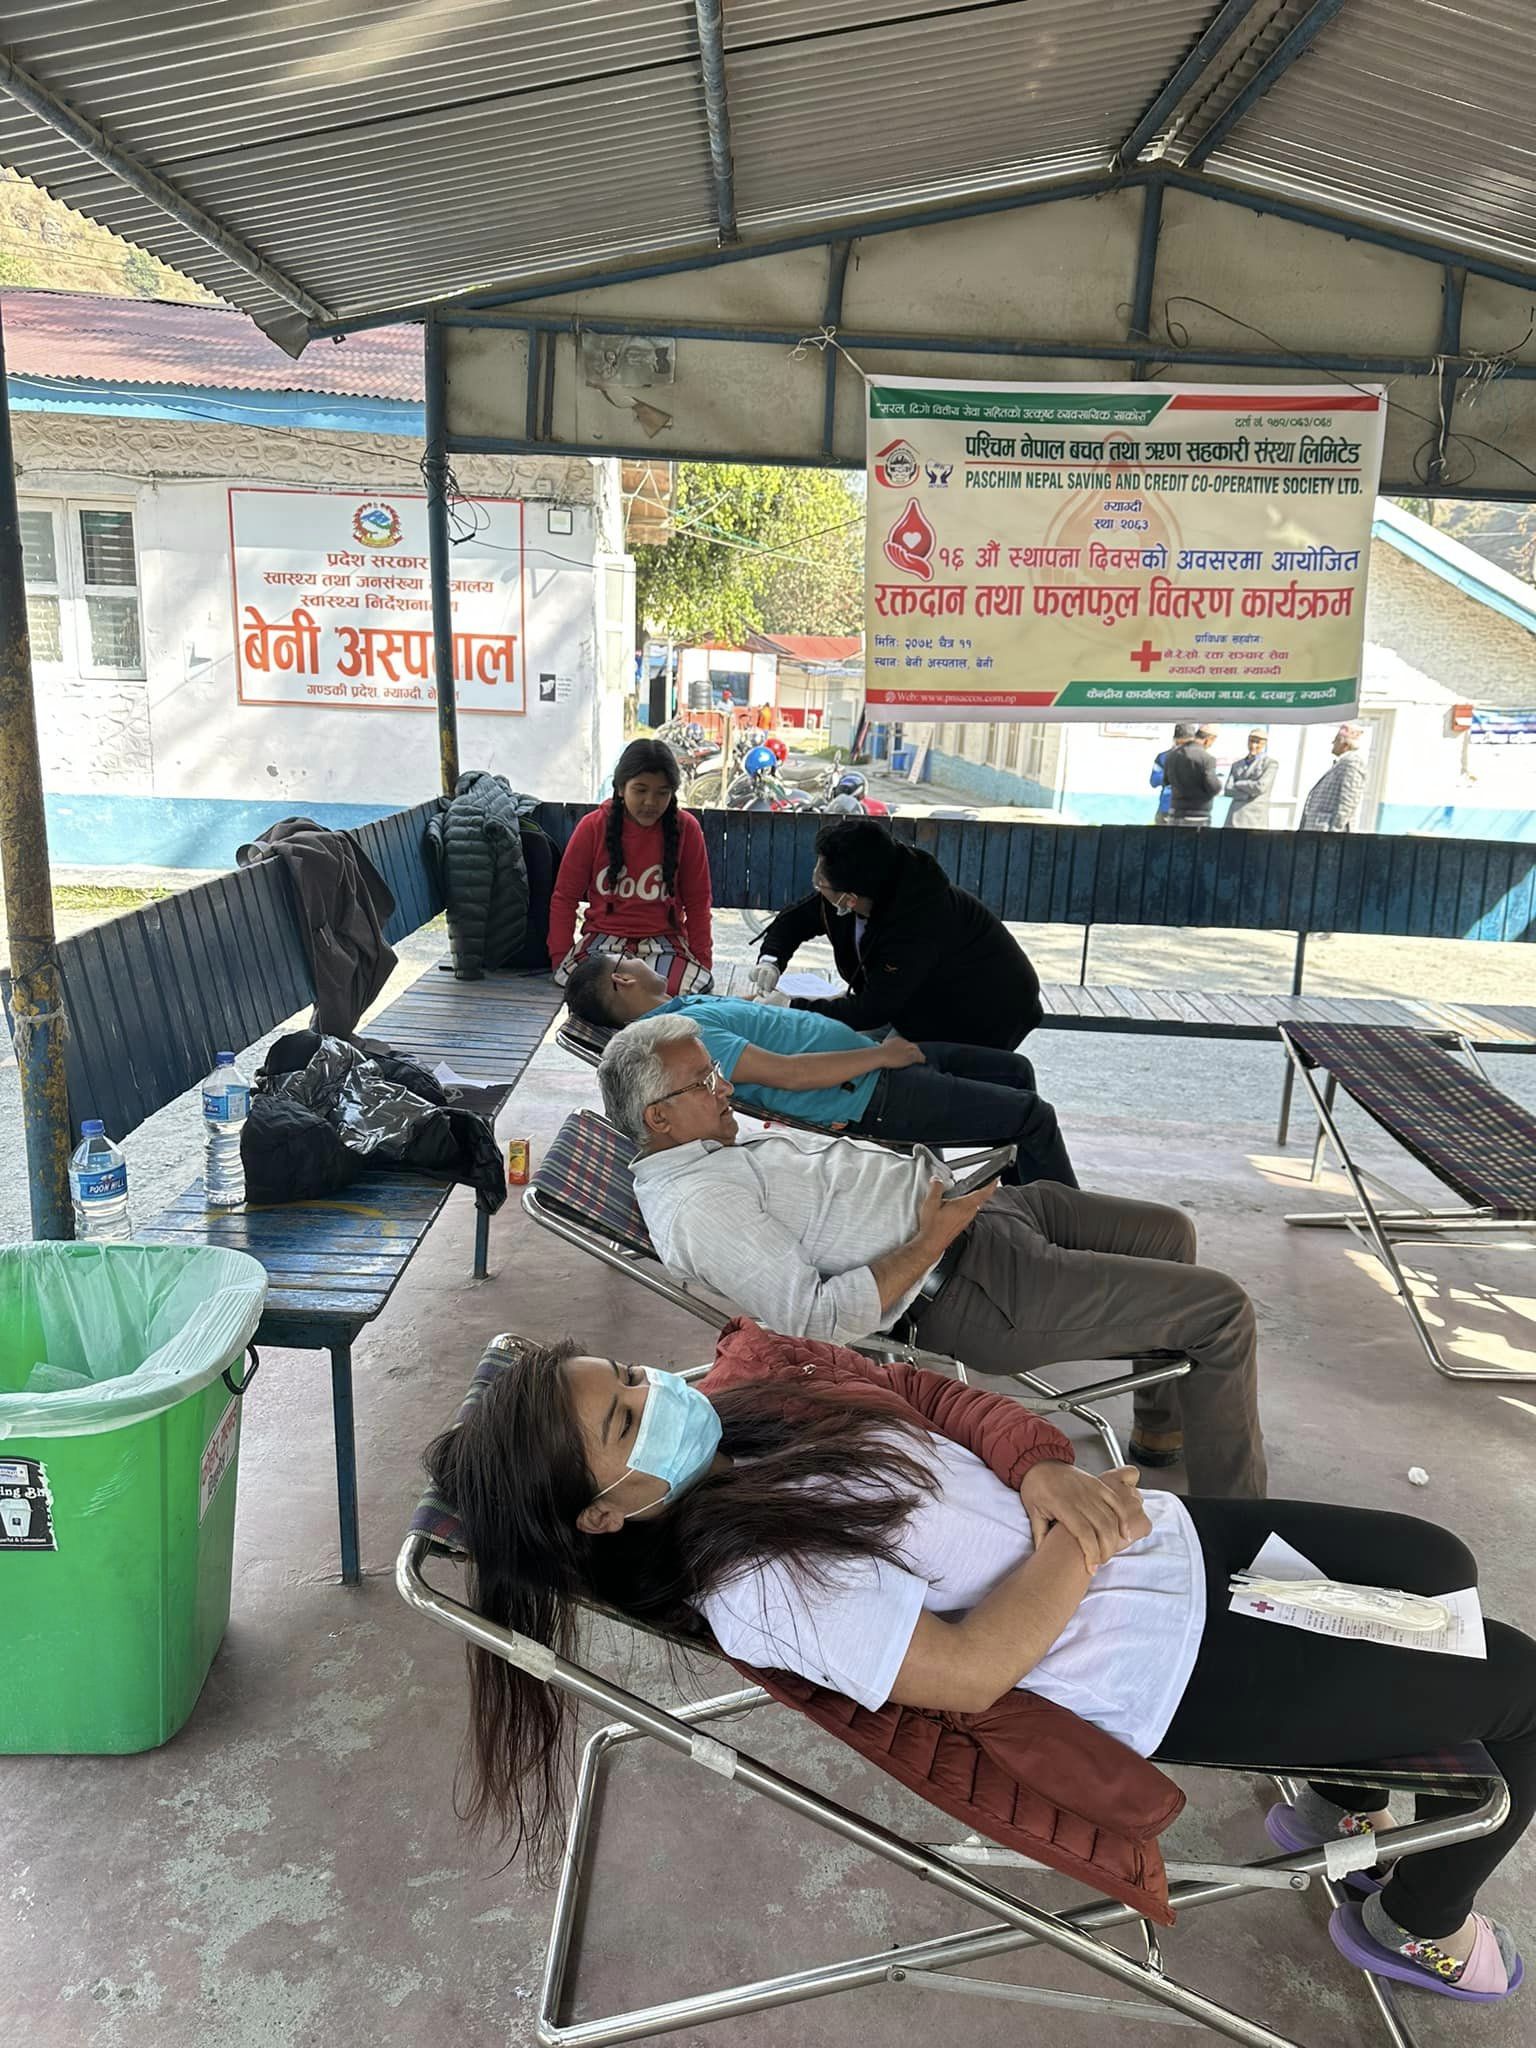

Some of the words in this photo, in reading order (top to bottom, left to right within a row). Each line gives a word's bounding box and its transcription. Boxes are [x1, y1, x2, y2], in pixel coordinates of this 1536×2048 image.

[962, 403, 980, 416] सेवा
[983, 405, 1020, 419] सहितको
[965, 430, 1016, 458] पश्चिम
[1021, 432, 1065, 460] नेपाल
[1069, 440, 1104, 460] बचत
[1109, 441, 1141, 461] तथा
[1144, 441, 1182, 461] ऋण
[1186, 436, 1250, 463] सहकारी
[1254, 437, 1296, 464] संस्था
[1299, 435, 1362, 464] लिमिटेड
[965, 470, 1022, 489] PASCHIM
[1025, 471, 1063, 489] NEPAL
[1067, 472, 1112, 490] SAVING
[1115, 472, 1140, 490] AND
[1144, 473, 1188, 492] CREDIT
[1191, 474, 1280, 494] CO-OPERATIVE
[1283, 476, 1336, 494] SOCIETY
[1337, 477, 1363, 495] LTD.
[1104, 499, 1142, 512] म्याग्दी
[1121, 519, 1149, 530] २०६३
[327, 550, 365, 567] प्रदेश
[371, 555, 429, 570] सरकार
[939, 547, 964, 571] १६
[1009, 547, 1081, 569] स्थापना
[1089, 542, 1168, 571] दिवसको
[1177, 549, 1263, 571] अवसरमा
[1271, 545, 1360, 571] आयोजित
[263, 571, 317, 586] स्वास्थ्य
[322, 574, 351, 587] तथा
[356, 574, 423, 590] जनसंख्या
[300, 594, 359, 608] स्वास्थ्य
[874, 583, 967, 617] रक्तदान
[975, 585, 1025, 617] तथा
[1033, 585, 1141, 626] फलफुल
[1150, 575, 1235, 619] वितरण
[1241, 579, 1354, 620] कार्यक्रम
[243, 606, 321, 674] बेनी
[905, 638, 933, 650] २०७९
[939, 635, 954, 648] चैत्र
[905, 655, 922, 667] बेनी
[976, 656, 994, 668] बेनी
[1269, 650, 1289, 660] सेवा
[1168, 665, 1205, 675] म्याग्दी
[1243, 665, 1281, 675] म्याग्दी
[307, 683, 347, 697] गण्डकी
[1300, 687, 1337, 699] म्याग्दी
